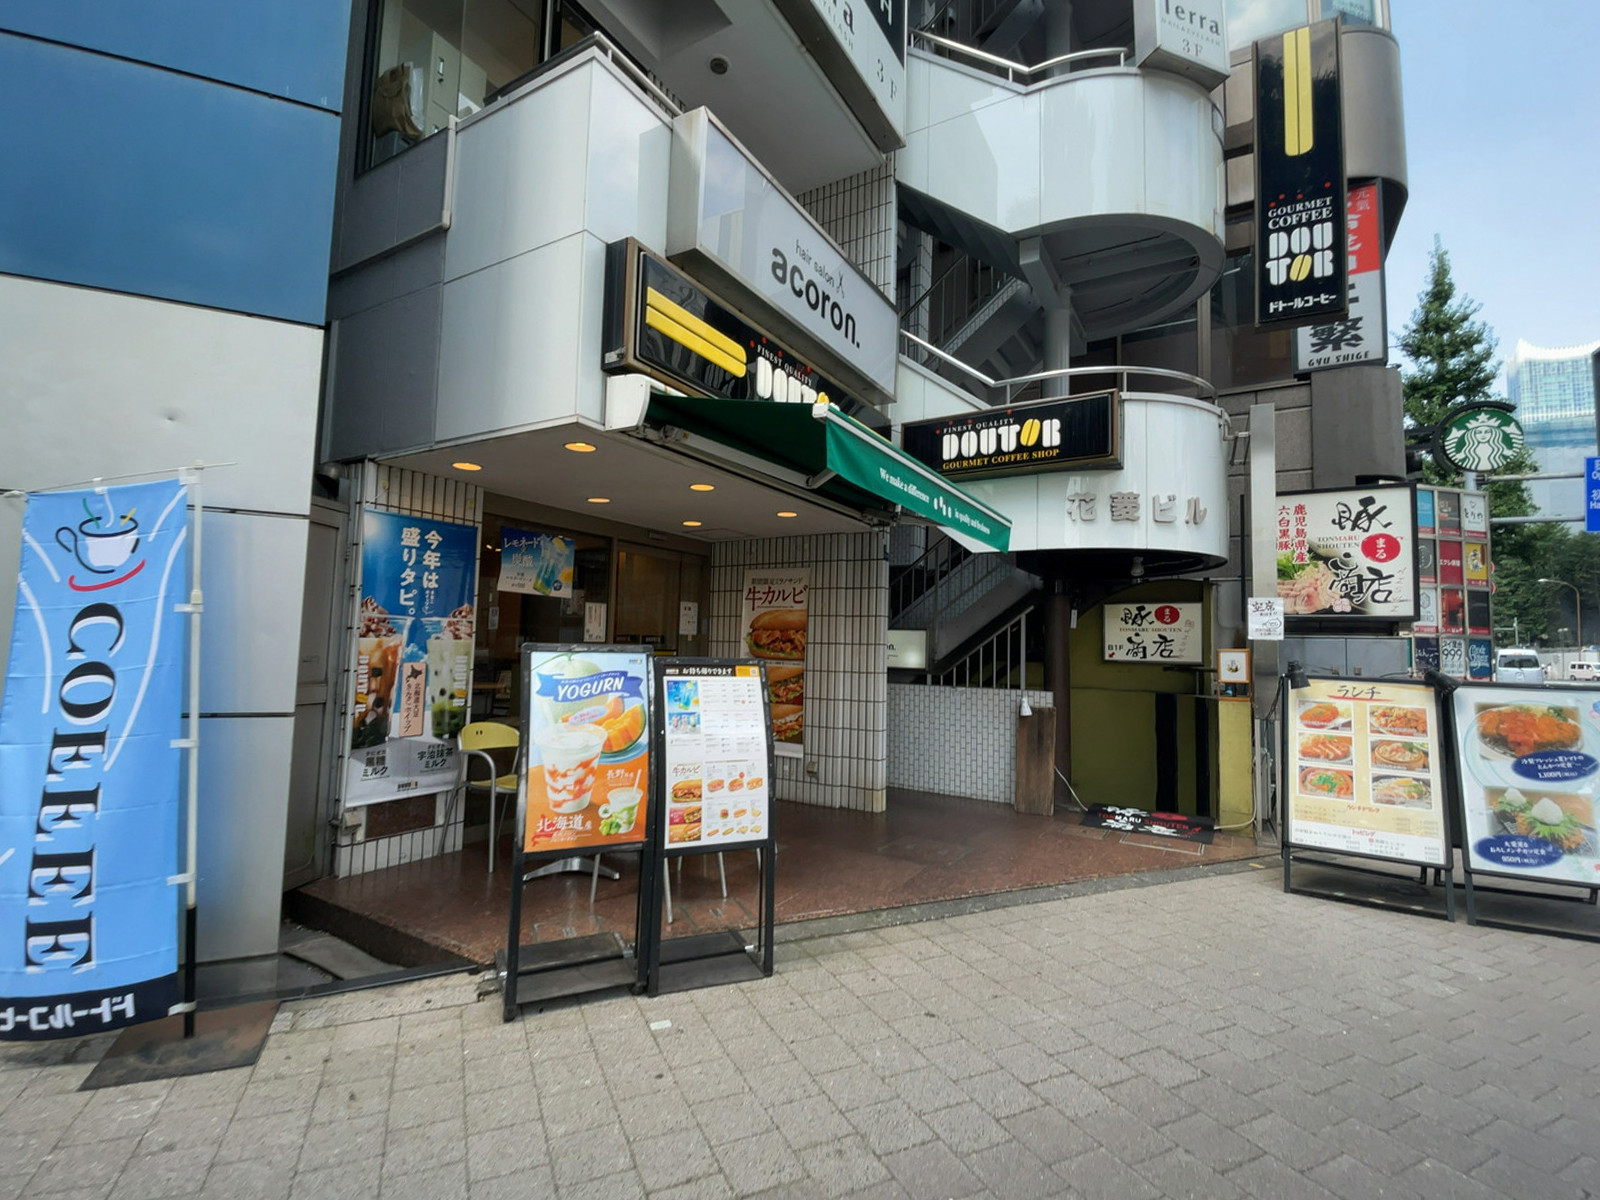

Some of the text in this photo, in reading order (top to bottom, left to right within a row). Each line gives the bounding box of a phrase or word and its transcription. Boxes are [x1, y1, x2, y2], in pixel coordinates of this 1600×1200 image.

[1267, 197, 1333, 218] GOURMET
[1267, 206, 1333, 230] COFFEE
[795, 239, 835, 288] hair salon
[771, 247, 860, 349] acoron.
[1269, 293, 1337, 314] ドトールコーヒー
[757, 344, 813, 387] FINEST QUALITY
[1308, 350, 1370, 367] GYU SHIGE
[943, 417, 1015, 434] FINEST QUALITY
[942, 418, 1061, 461] DOUTOR
[942, 448, 1060, 470] GOURMET COFFEE SHOP
[1067, 491, 1208, 525] 花菱ビル
[1278, 505, 1292, 552] 六白黒豚
[1293, 504, 1309, 564] 鹿児島県産
[1317, 535, 1360, 543] TONMARU
[1316, 542, 1359, 550] SHOUTEN
[1376, 537, 1387, 560] まる
[424, 530, 443, 588] 今年は
[400, 527, 421, 616] 盛りタピ。
[745, 584, 808, 612] 牛カルビ
[1441, 648, 1463, 660] 999
[682, 667, 733, 675] お持ち帰りできます
[557, 676, 625, 701] YOGURN
[1337, 685, 1382, 700] ランチ
